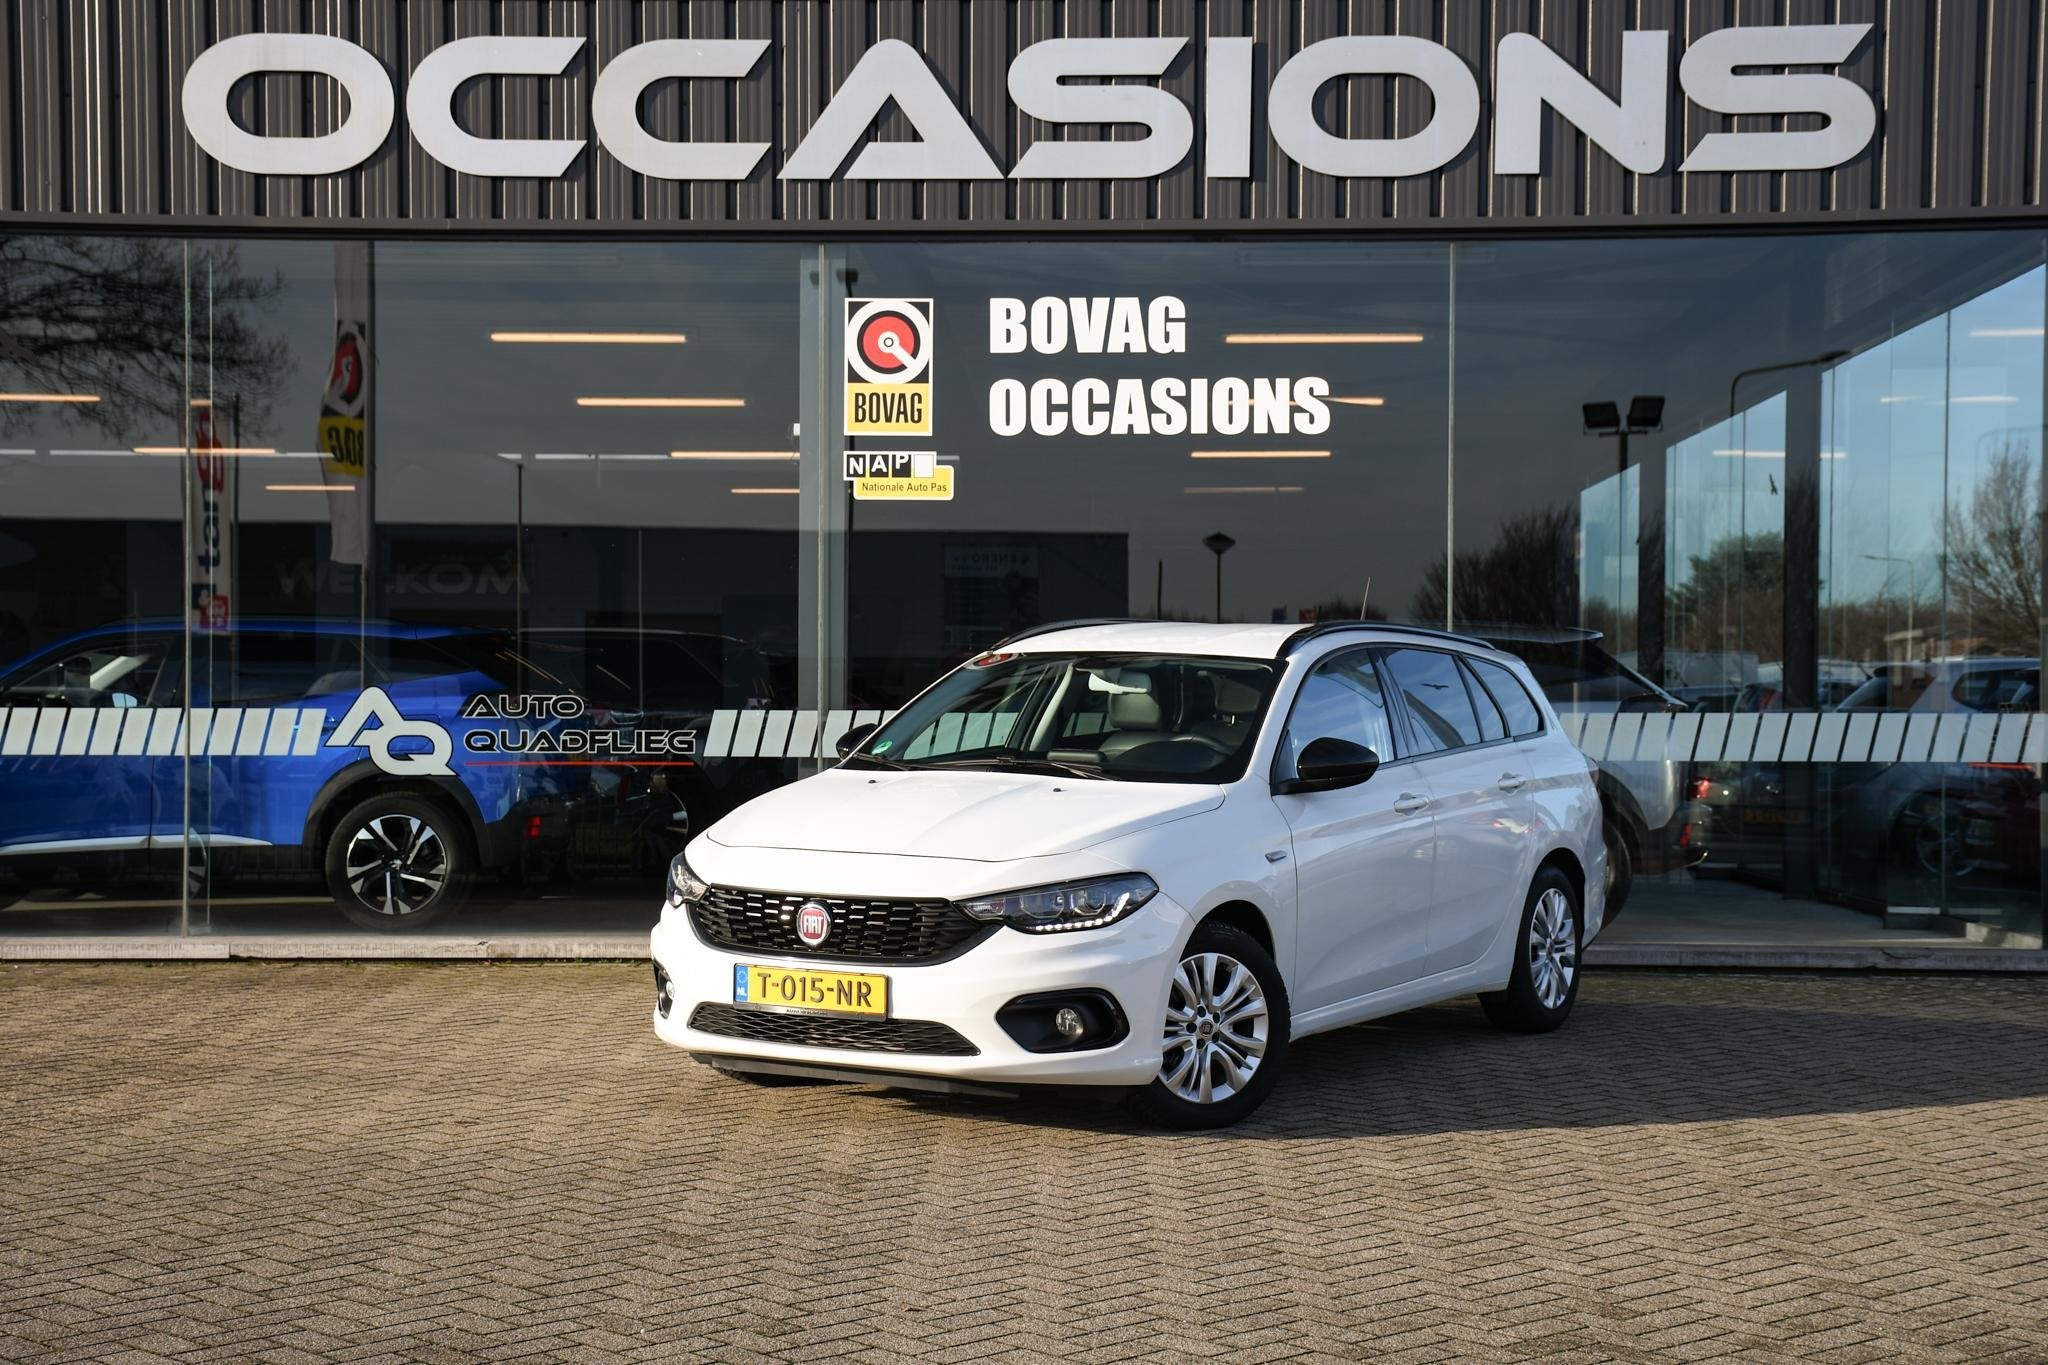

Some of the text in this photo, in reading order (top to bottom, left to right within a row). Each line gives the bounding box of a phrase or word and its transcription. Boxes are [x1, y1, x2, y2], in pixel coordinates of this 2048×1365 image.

[182, 22, 1877, 180] OCCASIONS
[989, 295, 1187, 355] BOVAG
[854, 392, 922, 424] BOVAG
[989, 376, 1331, 437] OCCASIONS
[849, 454, 909, 475] NAP
[861, 482, 948, 492] Nationale Auto Pas
[462, 694, 585, 719] AUTO
[326, 687, 456, 776] AQ
[463, 728, 697, 755] QUADFLIEG
[803, 915, 824, 935] FIAT
[736, 987, 748, 996] NL
[757, 972, 873, 1008] T-015-NR
